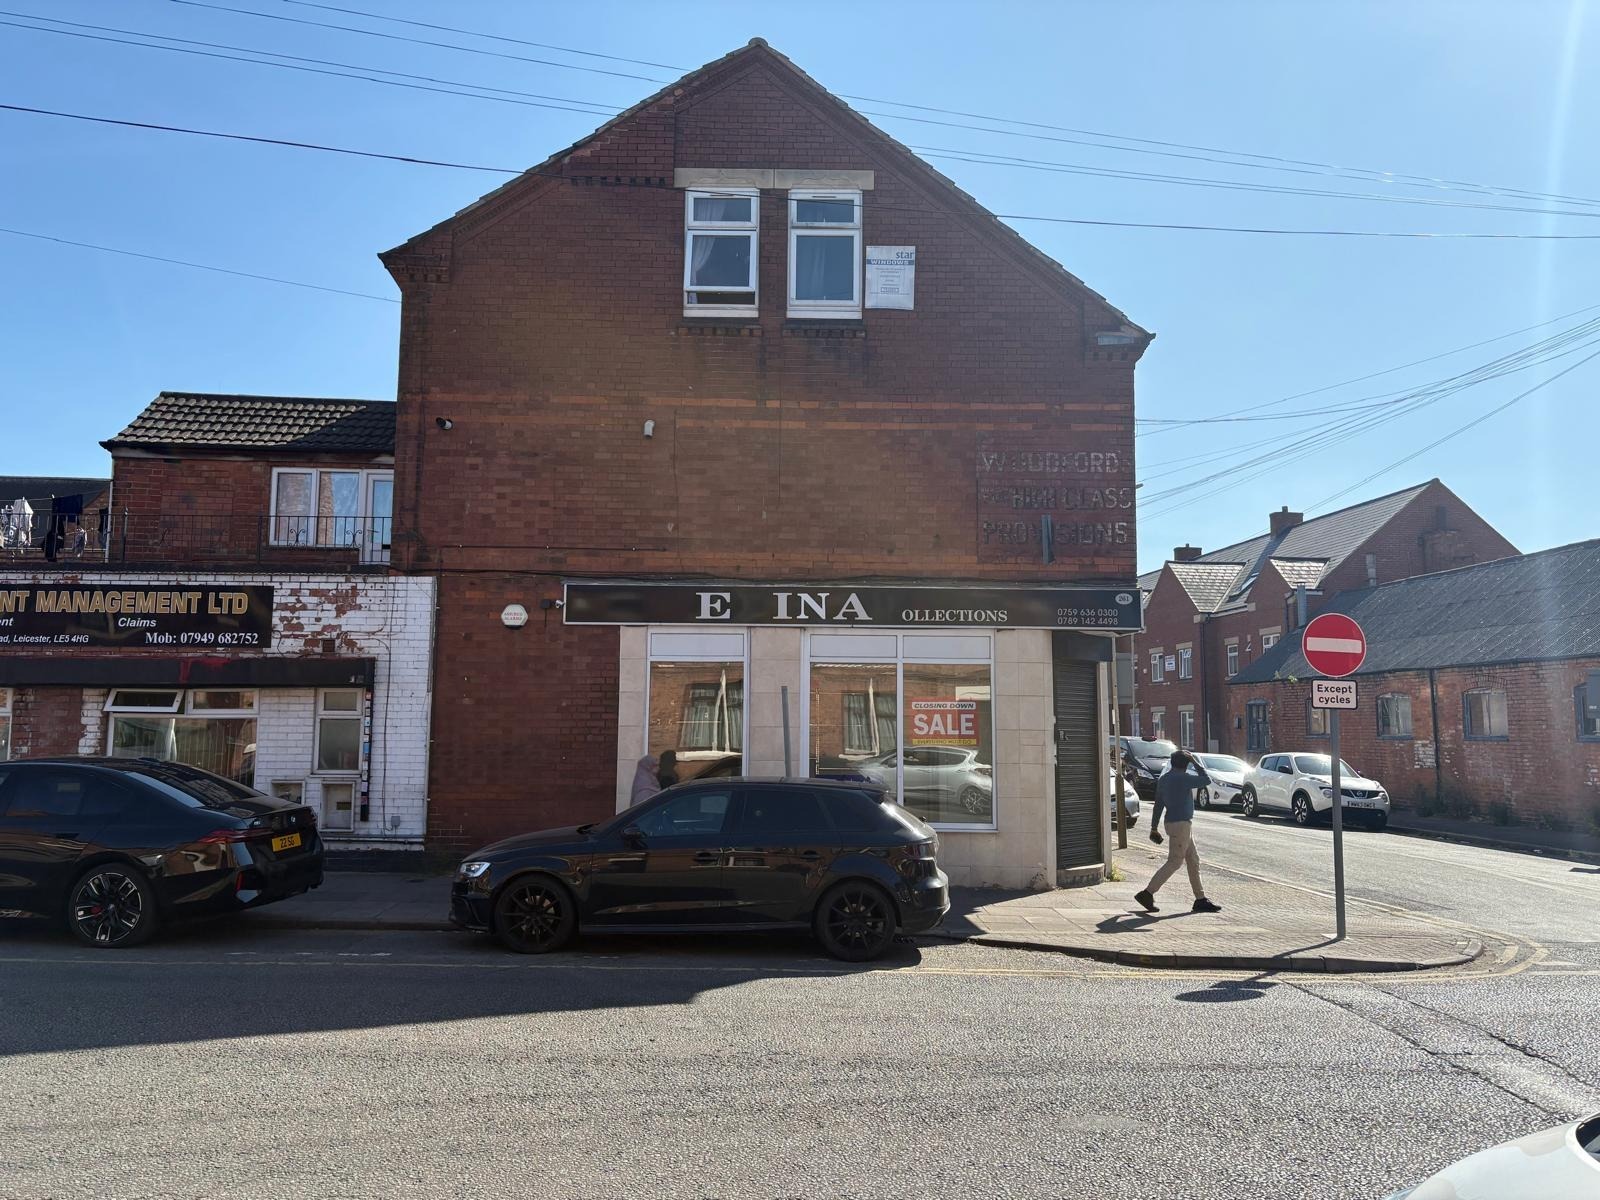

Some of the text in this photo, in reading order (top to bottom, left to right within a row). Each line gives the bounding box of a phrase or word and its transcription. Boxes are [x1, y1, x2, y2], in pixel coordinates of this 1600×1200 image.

[895, 251, 914, 259] star
[982, 521, 1127, 544] PROVSIONS
[35, 590, 202, 613] MANAGEMENT
[207, 591, 249, 615] LTD
[901, 609, 1008, 622] OLLECTIONS
[1057, 608, 1119, 617] 0759 636 0300
[0, 617, 14, 627] nt
[118, 617, 157, 627] Claims
[1057, 617, 1119, 625] 0789 142 4498
[13, 634, 52, 644] Leicester,
[53, 634, 70, 643] LE5
[71, 634, 89, 643] 4HG
[145, 632, 259, 645] Mob: 07949 682752
[1317, 684, 1353, 694] Except
[1318, 695, 1351, 704] cycles
[913, 713, 975, 735] SALE
